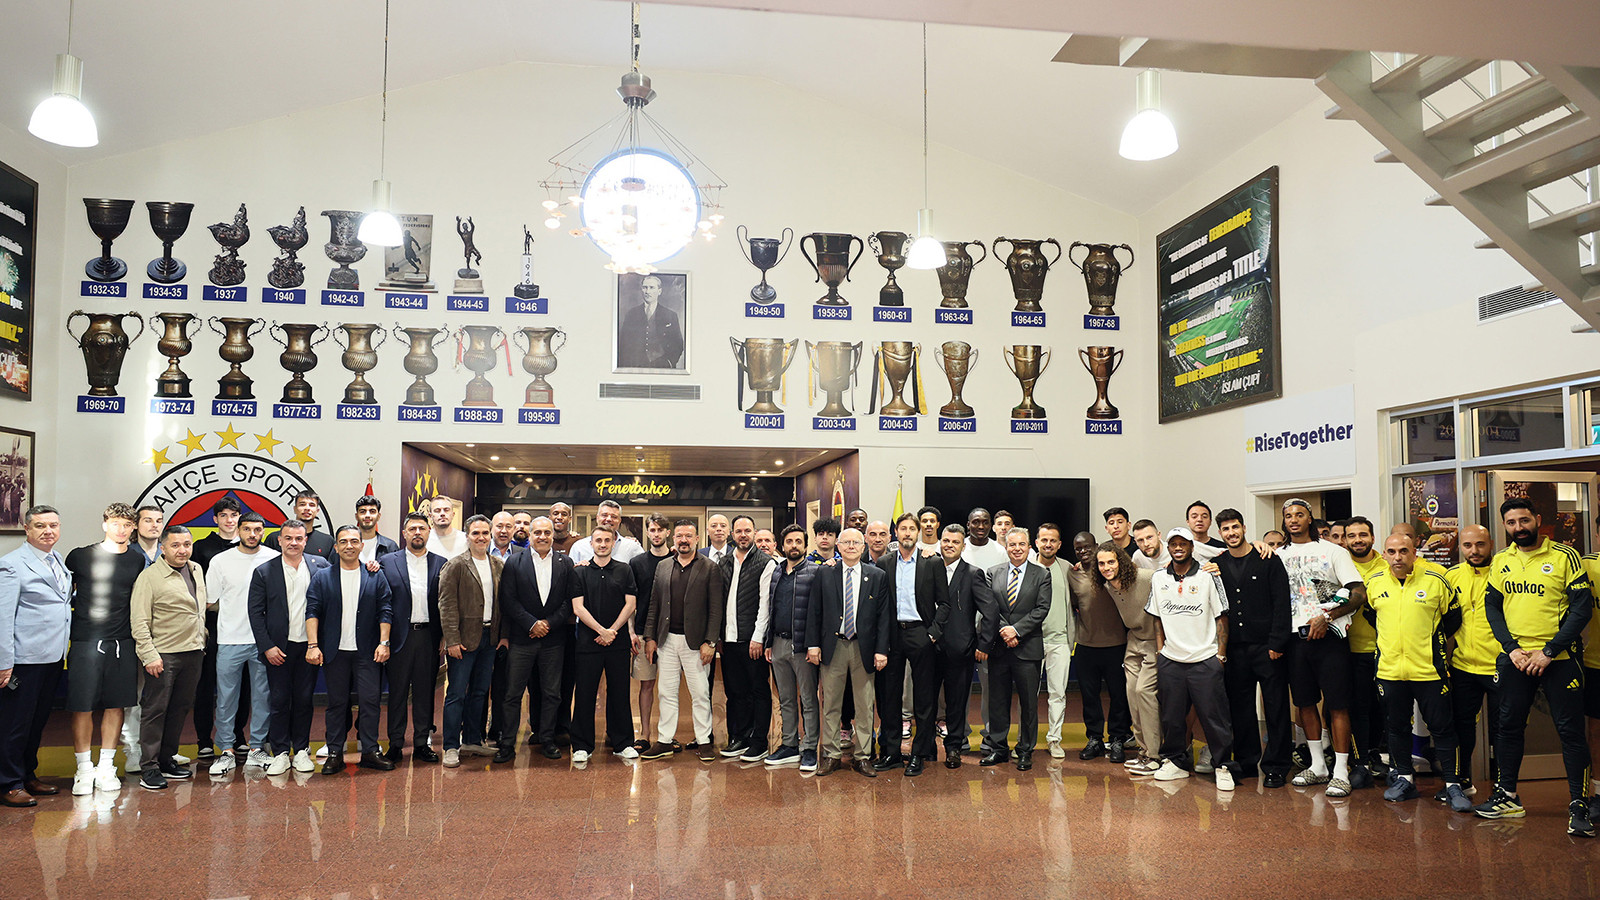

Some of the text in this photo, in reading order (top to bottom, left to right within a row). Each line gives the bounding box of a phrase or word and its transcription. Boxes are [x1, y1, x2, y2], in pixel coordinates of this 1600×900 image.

[1232, 248, 1261, 280] TITLE
[88, 284, 120, 295] 1932-33
[148, 287, 183, 298] 1934-35
[214, 288, 236, 300] 1937
[273, 291, 295, 302] 1940
[328, 293, 359, 305] 1942-43
[390, 297, 424, 308] 1943-44
[452, 299, 484, 310] 1944-45
[514, 302, 538, 312] 1946
[749, 306, 781, 316] 1949-50
[817, 308, 848, 318] 1958-59
[877, 310, 907, 320] 1960-61
[940, 312, 969, 322] 1963-64
[1014, 315, 1043, 325] 1964-65
[1089, 318, 1116, 328] 1967-68
[1222, 370, 1261, 394] İSLAM ÇUPİ
[84, 399, 119, 411] 1969-70
[154, 401, 192, 413] 1973-74
[215, 402, 254, 415] 1974-75
[277, 405, 318, 418] 1977-78
[341, 407, 377, 419] 1982-83
[401, 408, 438, 420] 1984-85
[458, 409, 498, 422] 1988-89
[523, 412, 556, 423] 1995-96
[749, 415, 781, 427] 2000-01
[818, 418, 852, 429] 2003-04
[882, 419, 913, 430] 2004-05
[943, 421, 973, 431] 2006-07
[1015, 422, 1044, 431] 2010-2011
[1089, 423, 1118, 433] 2013-14
[1246, 423, 1353, 453] #RiseTogether
[231, 463, 300, 506] SPOR
[595, 477, 671, 497] Fenerbahçe
[1504, 580, 1545, 597] Otokoç
[1161, 600, 1203, 615] Represent
